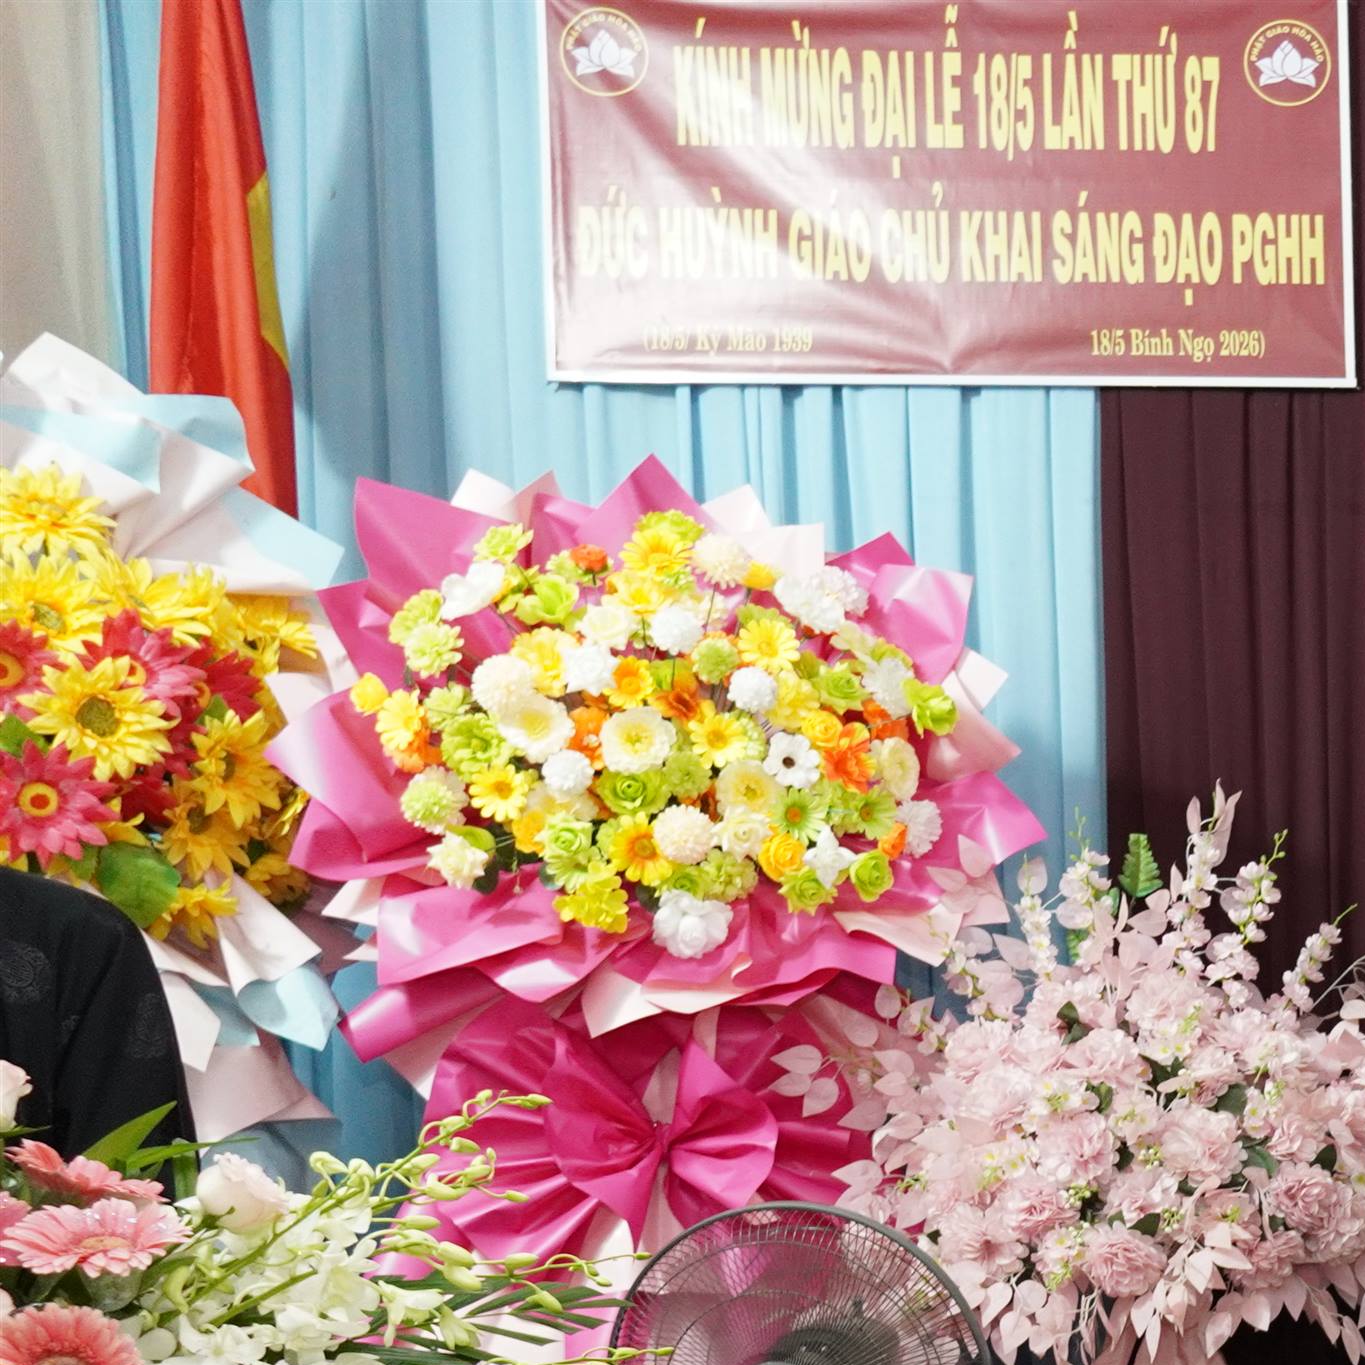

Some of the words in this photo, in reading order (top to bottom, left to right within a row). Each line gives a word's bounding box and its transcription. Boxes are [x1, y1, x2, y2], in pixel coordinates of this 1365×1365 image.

[673, 17, 751, 146] KÍNH
[760, 20, 855, 149] MỪNG
[861, 50, 917, 178] ĐẠI
[925, 4, 964, 149] LỄ
[973, 53, 1035, 161] 18/5
[1043, 10, 1104, 150] LẦN
[1112, 26, 1177, 154] THỨ
[1184, 55, 1220, 153] 87
[577, 185, 649, 279] ĐỨC
[658, 187, 778, 279] HUỲNH
[788, 188, 872, 283] GIÁO
[880, 181, 950, 284] CHỦ
[959, 211, 1043, 283] KHAI
[1051, 191, 1145, 285] SÁNG
[1153, 212, 1223, 306] ĐẠO
[1231, 212, 1325, 286] PGHH
[774, 326, 814, 352] 1939
[1090, 329, 1126, 357] 18/5
[1130, 328, 1174, 356] Bính
[1178, 329, 1215, 362] Ngọ
[1219, 330, 1266, 359] 2026)
